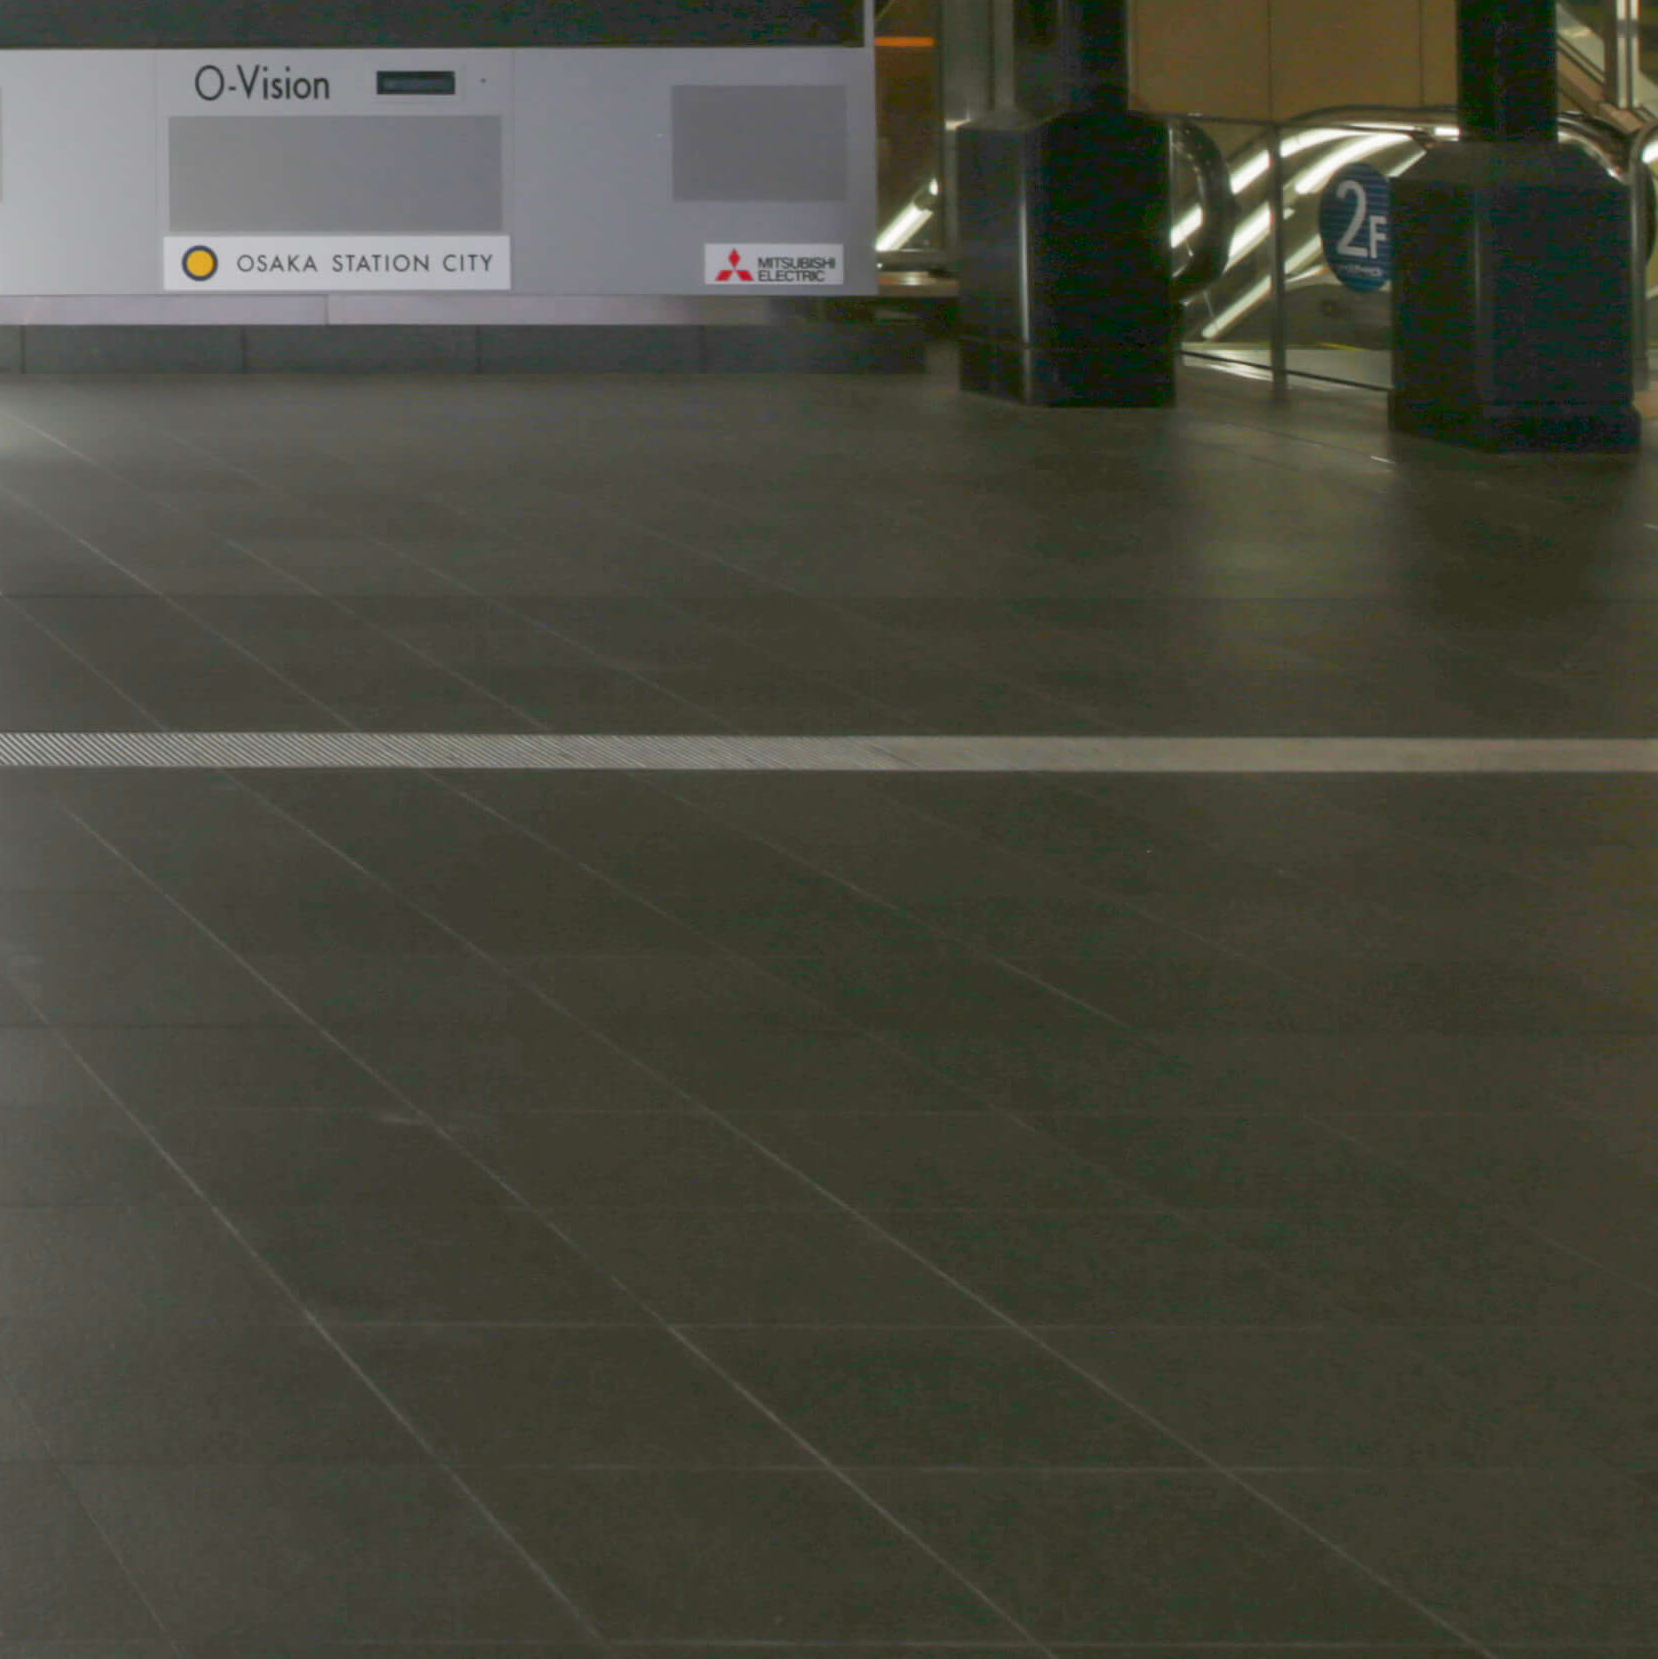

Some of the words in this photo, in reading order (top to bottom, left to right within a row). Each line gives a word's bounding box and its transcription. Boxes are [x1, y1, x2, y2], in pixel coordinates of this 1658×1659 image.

[194, 64, 330, 102] O-Vision
[1336, 180, 1388, 259] 2F
[236, 254, 318, 273] OSAKA
[331, 253, 430, 273] STATION
[442, 252, 494, 273] CITY
[758, 257, 836, 269] MITSUBISHI
[758, 270, 826, 282] ELECTRIC
